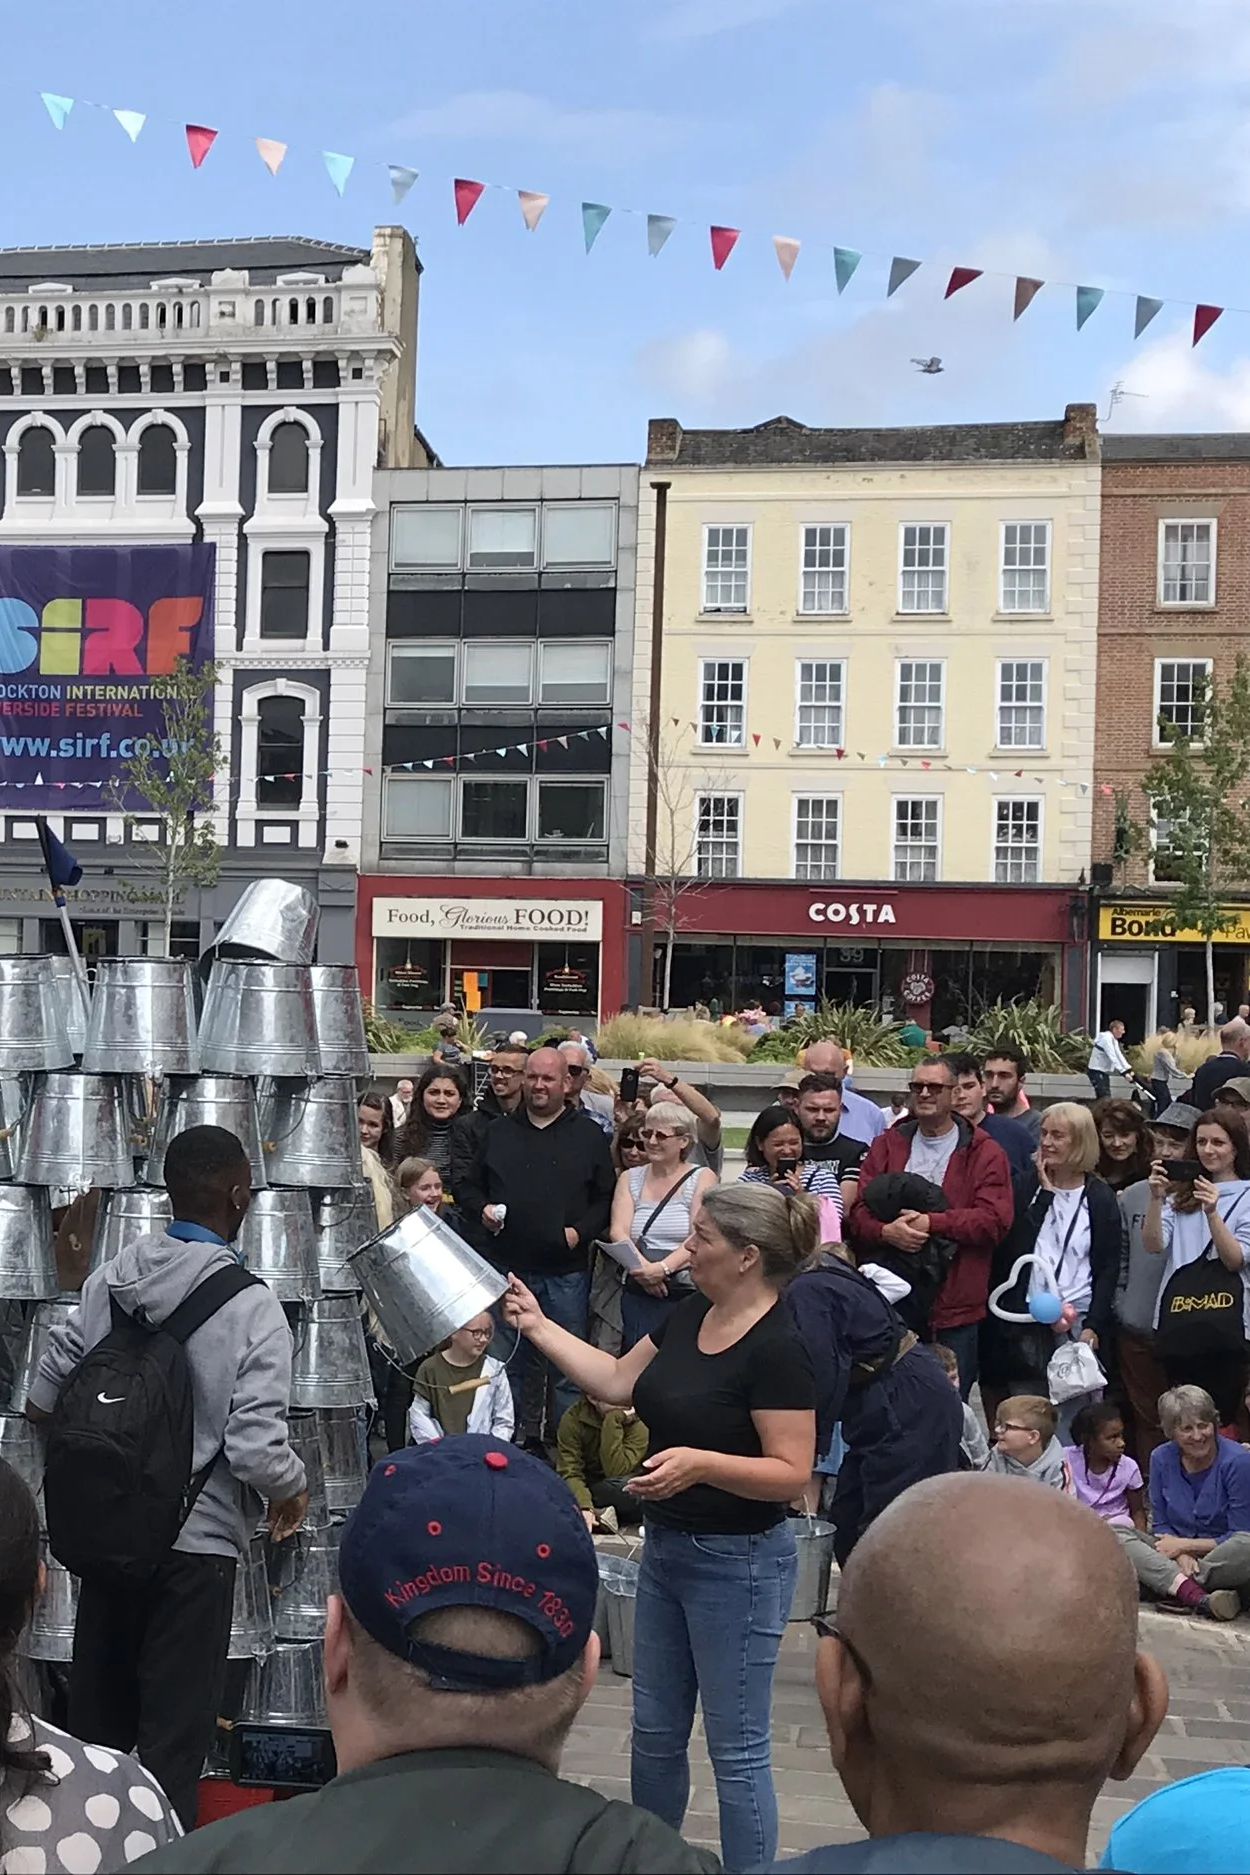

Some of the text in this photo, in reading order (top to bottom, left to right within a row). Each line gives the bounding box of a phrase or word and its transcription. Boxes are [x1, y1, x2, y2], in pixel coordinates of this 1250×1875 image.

[66, 685, 197, 700] INTERNATION
[65, 703, 143, 718] FESTIVAL
[387, 904, 590, 928] Food, Glorious FOOD!
[808, 902, 896, 925] COSTA
[1111, 908, 1162, 917] Albemarle
[839, 947, 864, 963] 39
[906, 973, 929, 983] COSTA
[903, 989, 931, 1002] COFFEE
[382, 1561, 575, 1638] Kingdom Since 1830
